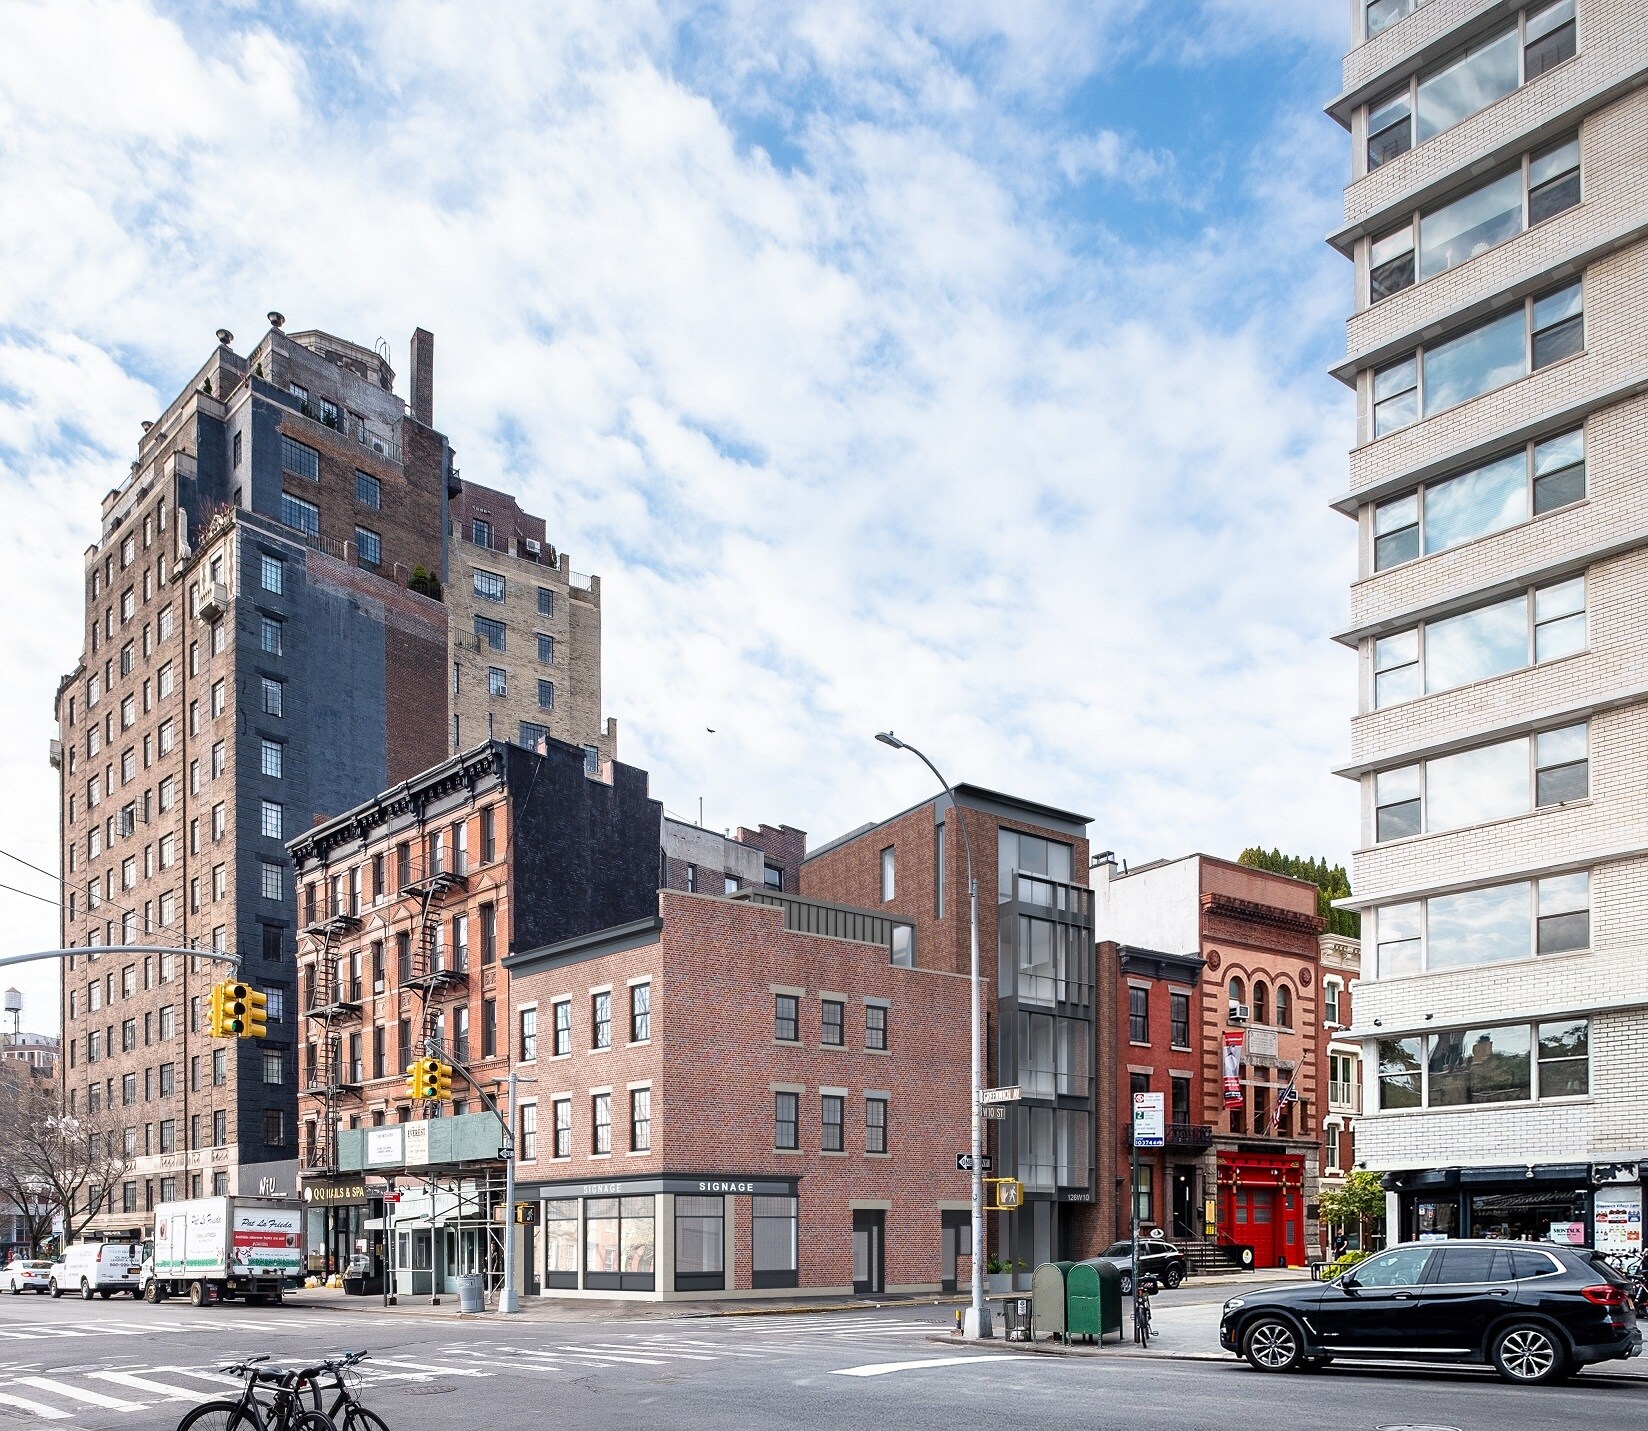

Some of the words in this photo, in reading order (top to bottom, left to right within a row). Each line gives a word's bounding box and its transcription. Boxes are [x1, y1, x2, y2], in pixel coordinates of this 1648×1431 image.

[983, 1089, 1011, 1102] GREENWICH
[988, 1107, 994, 1117] 10
[996, 1108, 1004, 1118] ST
[583, 1183, 622, 1194] SIGNAGE
[699, 1182, 754, 1192] SIGNAGE
[313, 1188, 325, 1201] QQ
[345, 1187, 351, 1198] &
[352, 1186, 365, 1198] SPA
[241, 1218, 256, 1227] Pat
[256, 1219, 267, 1227] La
